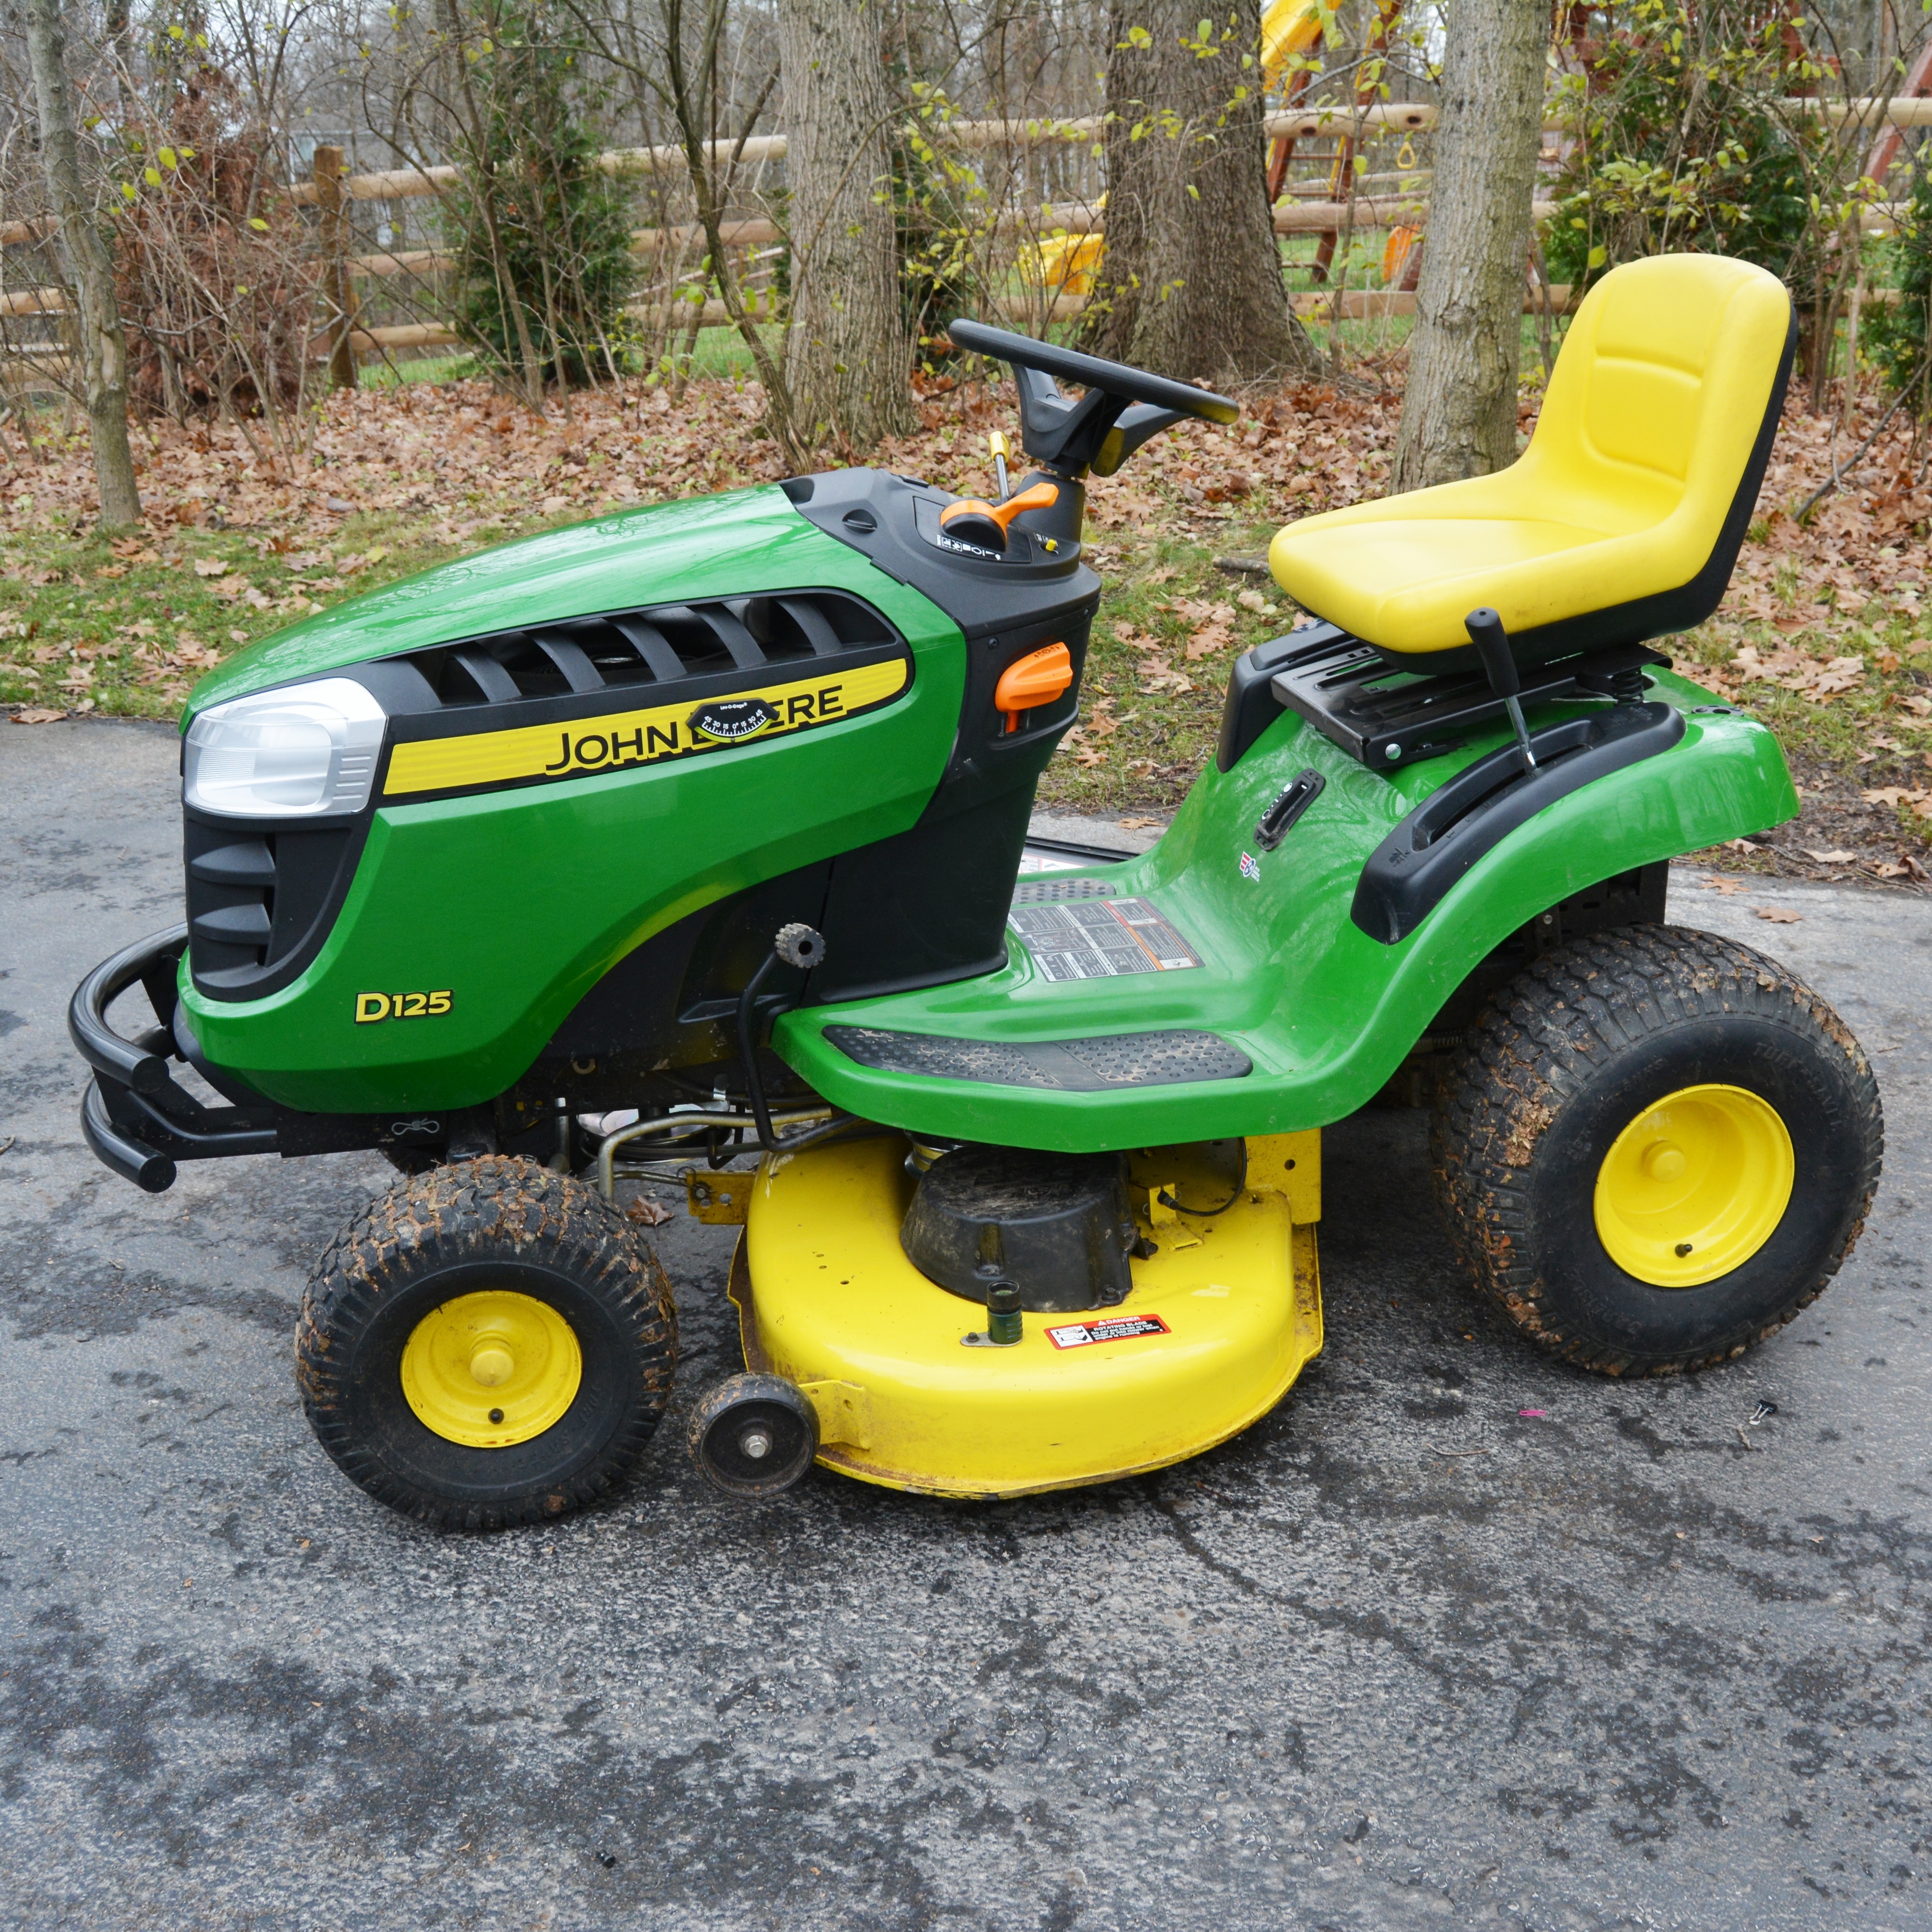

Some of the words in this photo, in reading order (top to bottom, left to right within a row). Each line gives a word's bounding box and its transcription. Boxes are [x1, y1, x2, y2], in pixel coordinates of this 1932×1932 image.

[545, 721, 678, 771] JOHN
[690, 685, 843, 745] ERE
[756, 709, 763, 717] 45
[356, 990, 451, 1022] D125
